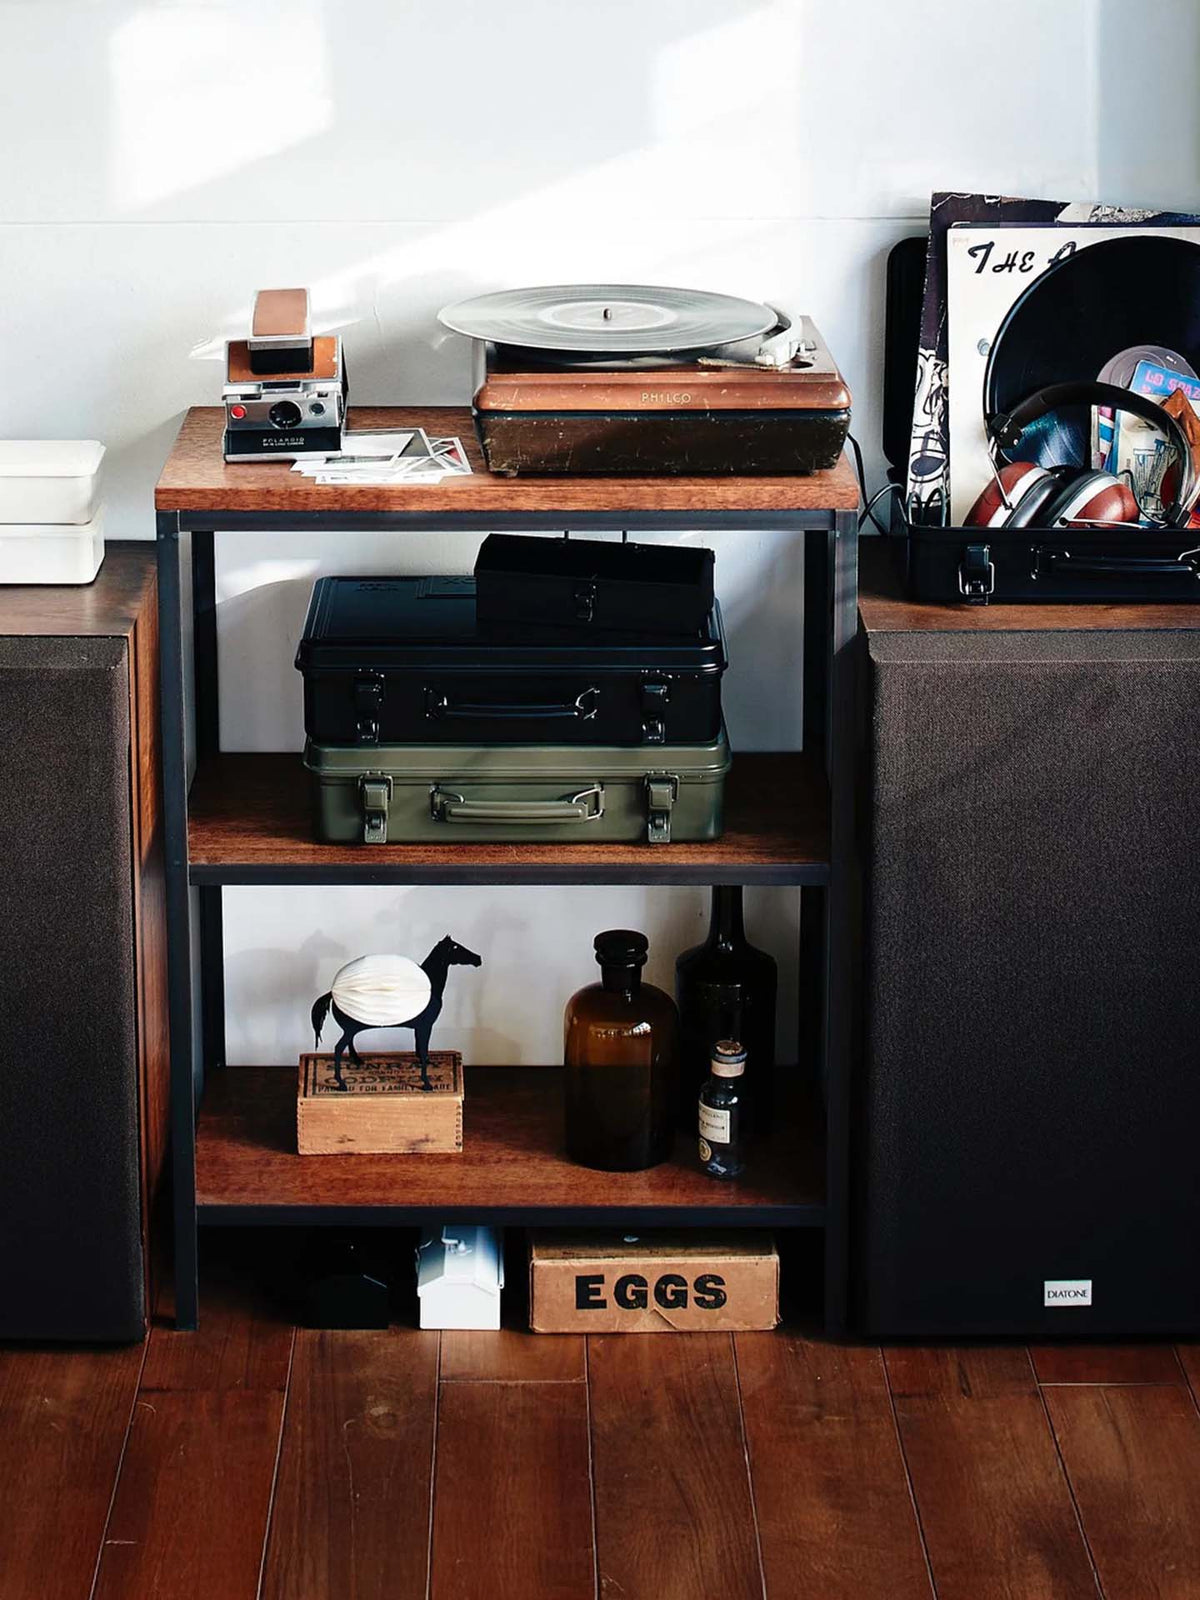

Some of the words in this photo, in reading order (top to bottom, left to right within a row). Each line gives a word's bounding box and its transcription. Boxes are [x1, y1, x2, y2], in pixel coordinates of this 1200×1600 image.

[968, 241, 1035, 273] THE
[641, 392, 691, 404] PHILCO
[575, 1274, 728, 1310] EGGS
[1047, 1289, 1088, 1299] DIATONE
